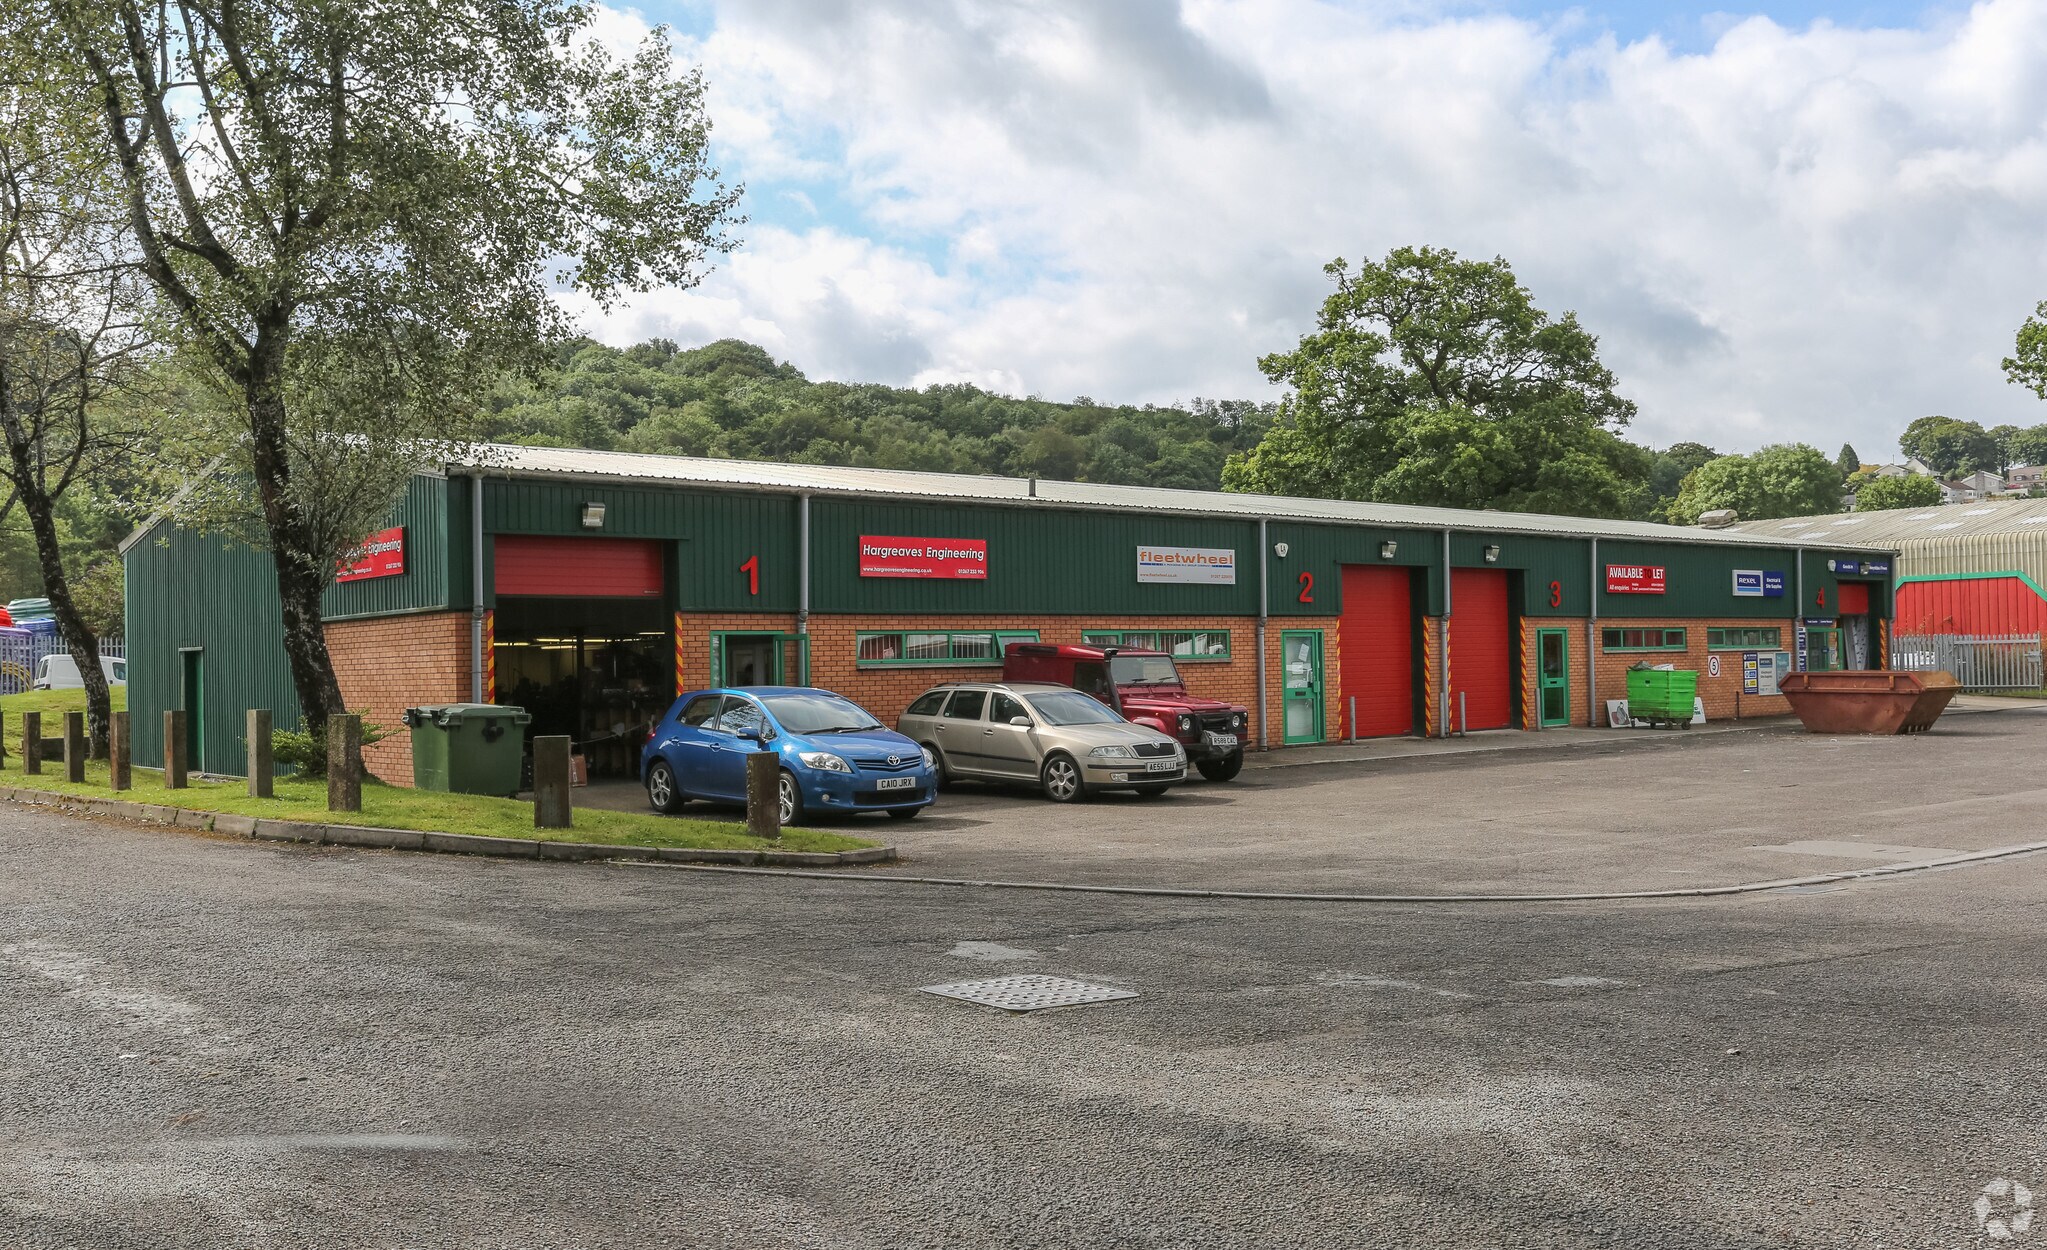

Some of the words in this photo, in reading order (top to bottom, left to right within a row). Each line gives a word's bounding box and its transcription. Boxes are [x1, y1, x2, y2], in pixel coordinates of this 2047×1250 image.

[862, 544, 922, 558] Hargreaves
[926, 546, 984, 561] Engineering
[1140, 551, 1233, 564] fleetwheel
[740, 555, 758, 595] 1
[1609, 567, 1643, 579] AVAILABLE
[1644, 569, 1652, 578] TO
[1652, 569, 1664, 579] LET
[1299, 571, 1313, 602] 2
[1551, 581, 1561, 607] 3
[1816, 587, 1825, 609] 4
[1712, 661, 1717, 670] 5
[1149, 763, 1164, 771] AE55
[881, 780, 897, 788] CA10
[899, 778, 912, 787] JRX
